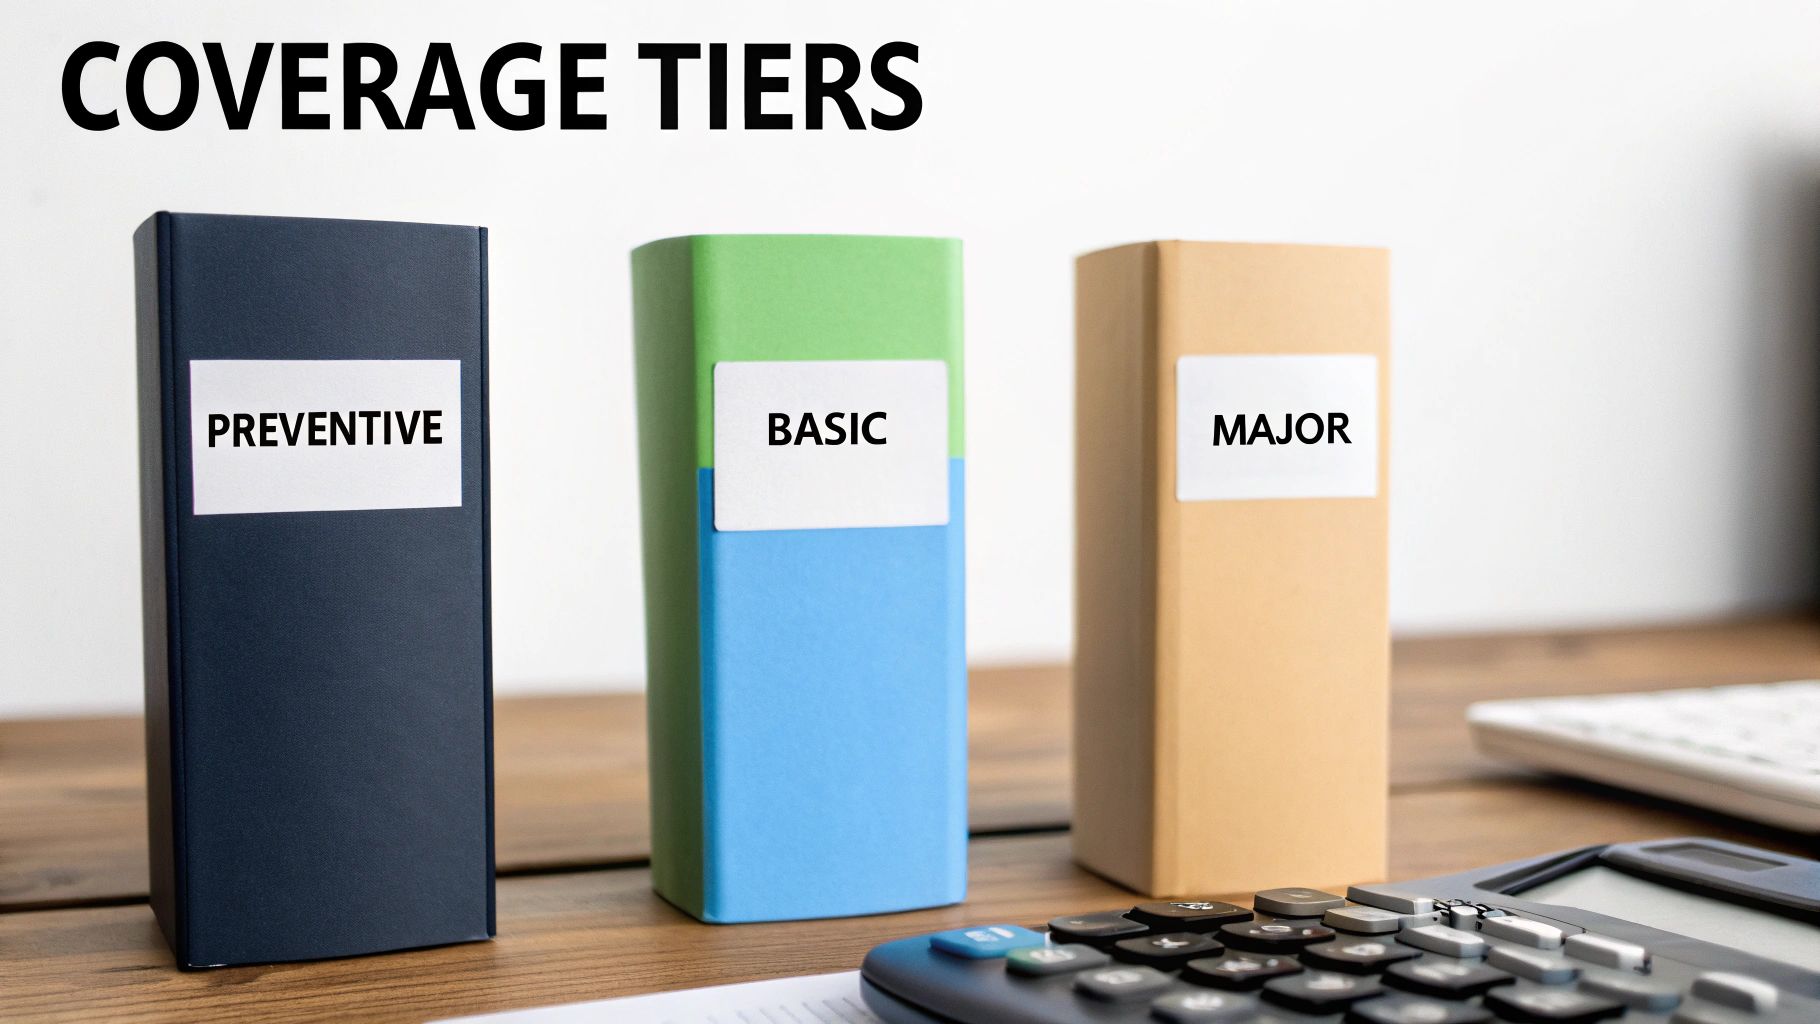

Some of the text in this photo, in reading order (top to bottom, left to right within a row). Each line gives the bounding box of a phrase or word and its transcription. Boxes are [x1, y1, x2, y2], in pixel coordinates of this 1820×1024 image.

[207, 410, 443, 448] PREVENTIVE
[767, 411, 888, 447] BASIC
[1211, 412, 1353, 447] MAJOR
